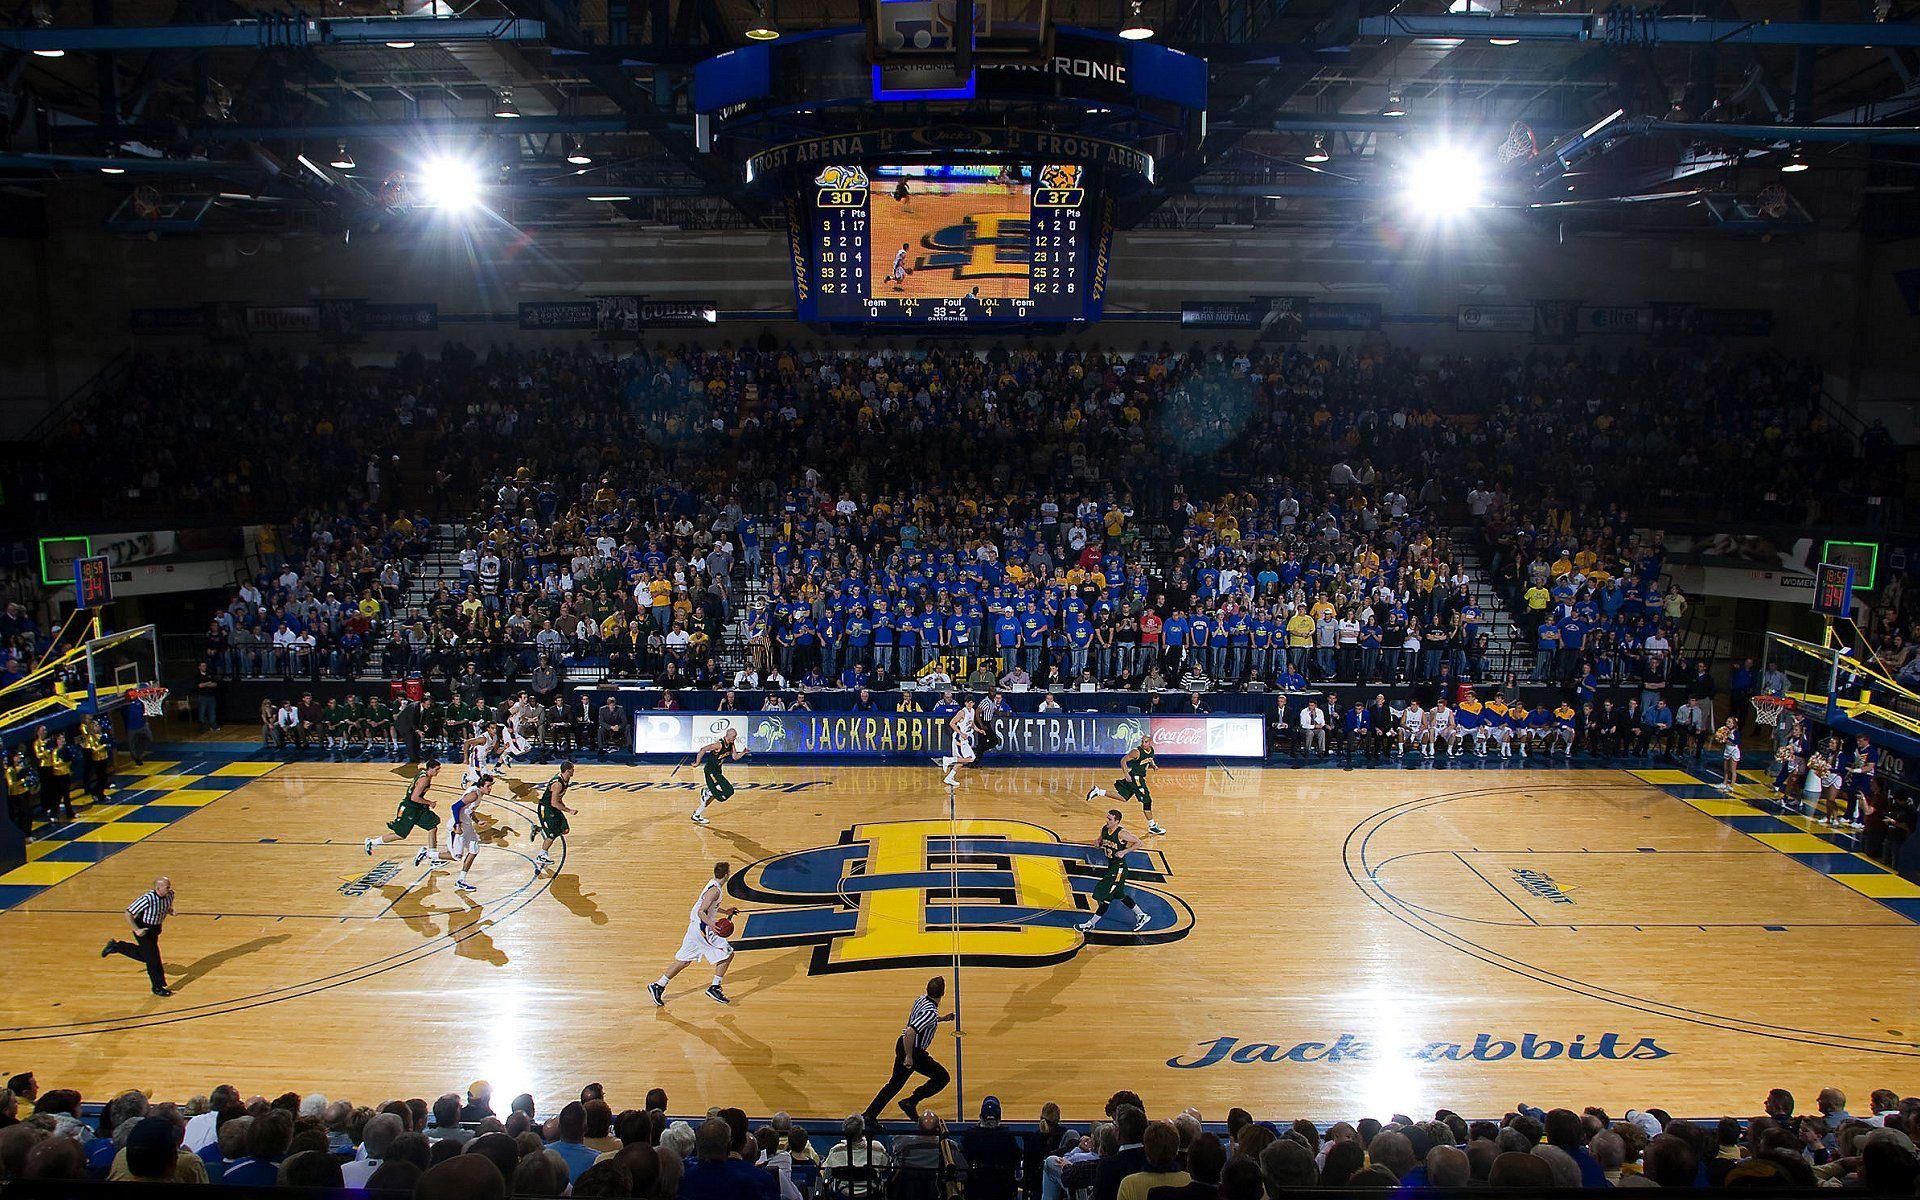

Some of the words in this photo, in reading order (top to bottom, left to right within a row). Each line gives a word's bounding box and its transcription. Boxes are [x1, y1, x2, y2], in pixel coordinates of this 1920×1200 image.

[1037, 135, 1100, 160] FROST
[754, 150, 788, 174] FROST
[796, 137, 864, 163] ARENA
[831, 192, 852, 204] 30
[1049, 192, 1070, 204] 37
[840, 210, 846, 218] F
[851, 210, 866, 218] Pts
[1066, 209, 1081, 218] Pts
[823, 221, 831, 231] 3
[840, 221, 846, 231] 1
[853, 221, 865, 231] 17
[1037, 220, 1045, 231] 4
[1053, 220, 1061, 231] 2
[1068, 220, 1076, 231] 0
[823, 237, 831, 247] 5
[839, 237, 847, 247] 2
[855, 237, 862, 247] 0
[1035, 236, 1047, 247] 12
[1053, 236, 1061, 247] 2
[1068, 236, 1076, 247] 4
[822, 252, 834, 262] 10
[840, 252, 847, 262] 0
[855, 252, 862, 262] 4
[1034, 252, 1047, 262] 23
[1054, 252, 1060, 262] 1
[1068, 252, 1075, 262] 7
[821, 268, 834, 278] 33
[840, 268, 847, 278] 2
[855, 268, 862, 278] 0
[1034, 268, 1047, 278] 25
[1052, 268, 1060, 278] 2
[1068, 268, 1075, 278] 7
[821, 283, 834, 294] 42
[840, 283, 847, 294] 2
[857, 283, 862, 294] 1
[1033, 283, 1047, 294] 42
[1052, 283, 1060, 294] 2
[1067, 283, 1075, 294] 8
[863, 299, 887, 307] Team
[943, 299, 962, 307] Foul
[1011, 299, 1035, 307] Team
[871, 307, 878, 317] 0
[905, 307, 912, 317] 4
[985, 307, 993, 317] 4
[1018, 307, 1026, 317] 0
[1221, 313, 1250, 322] MUTUAL
[1824, 584, 1844, 608] 34
[806, 717, 945, 751] JACKRABBIT
[978, 717, 1102, 753] SKETBALL
[1165, 1033, 1678, 1069] Jackabbits
